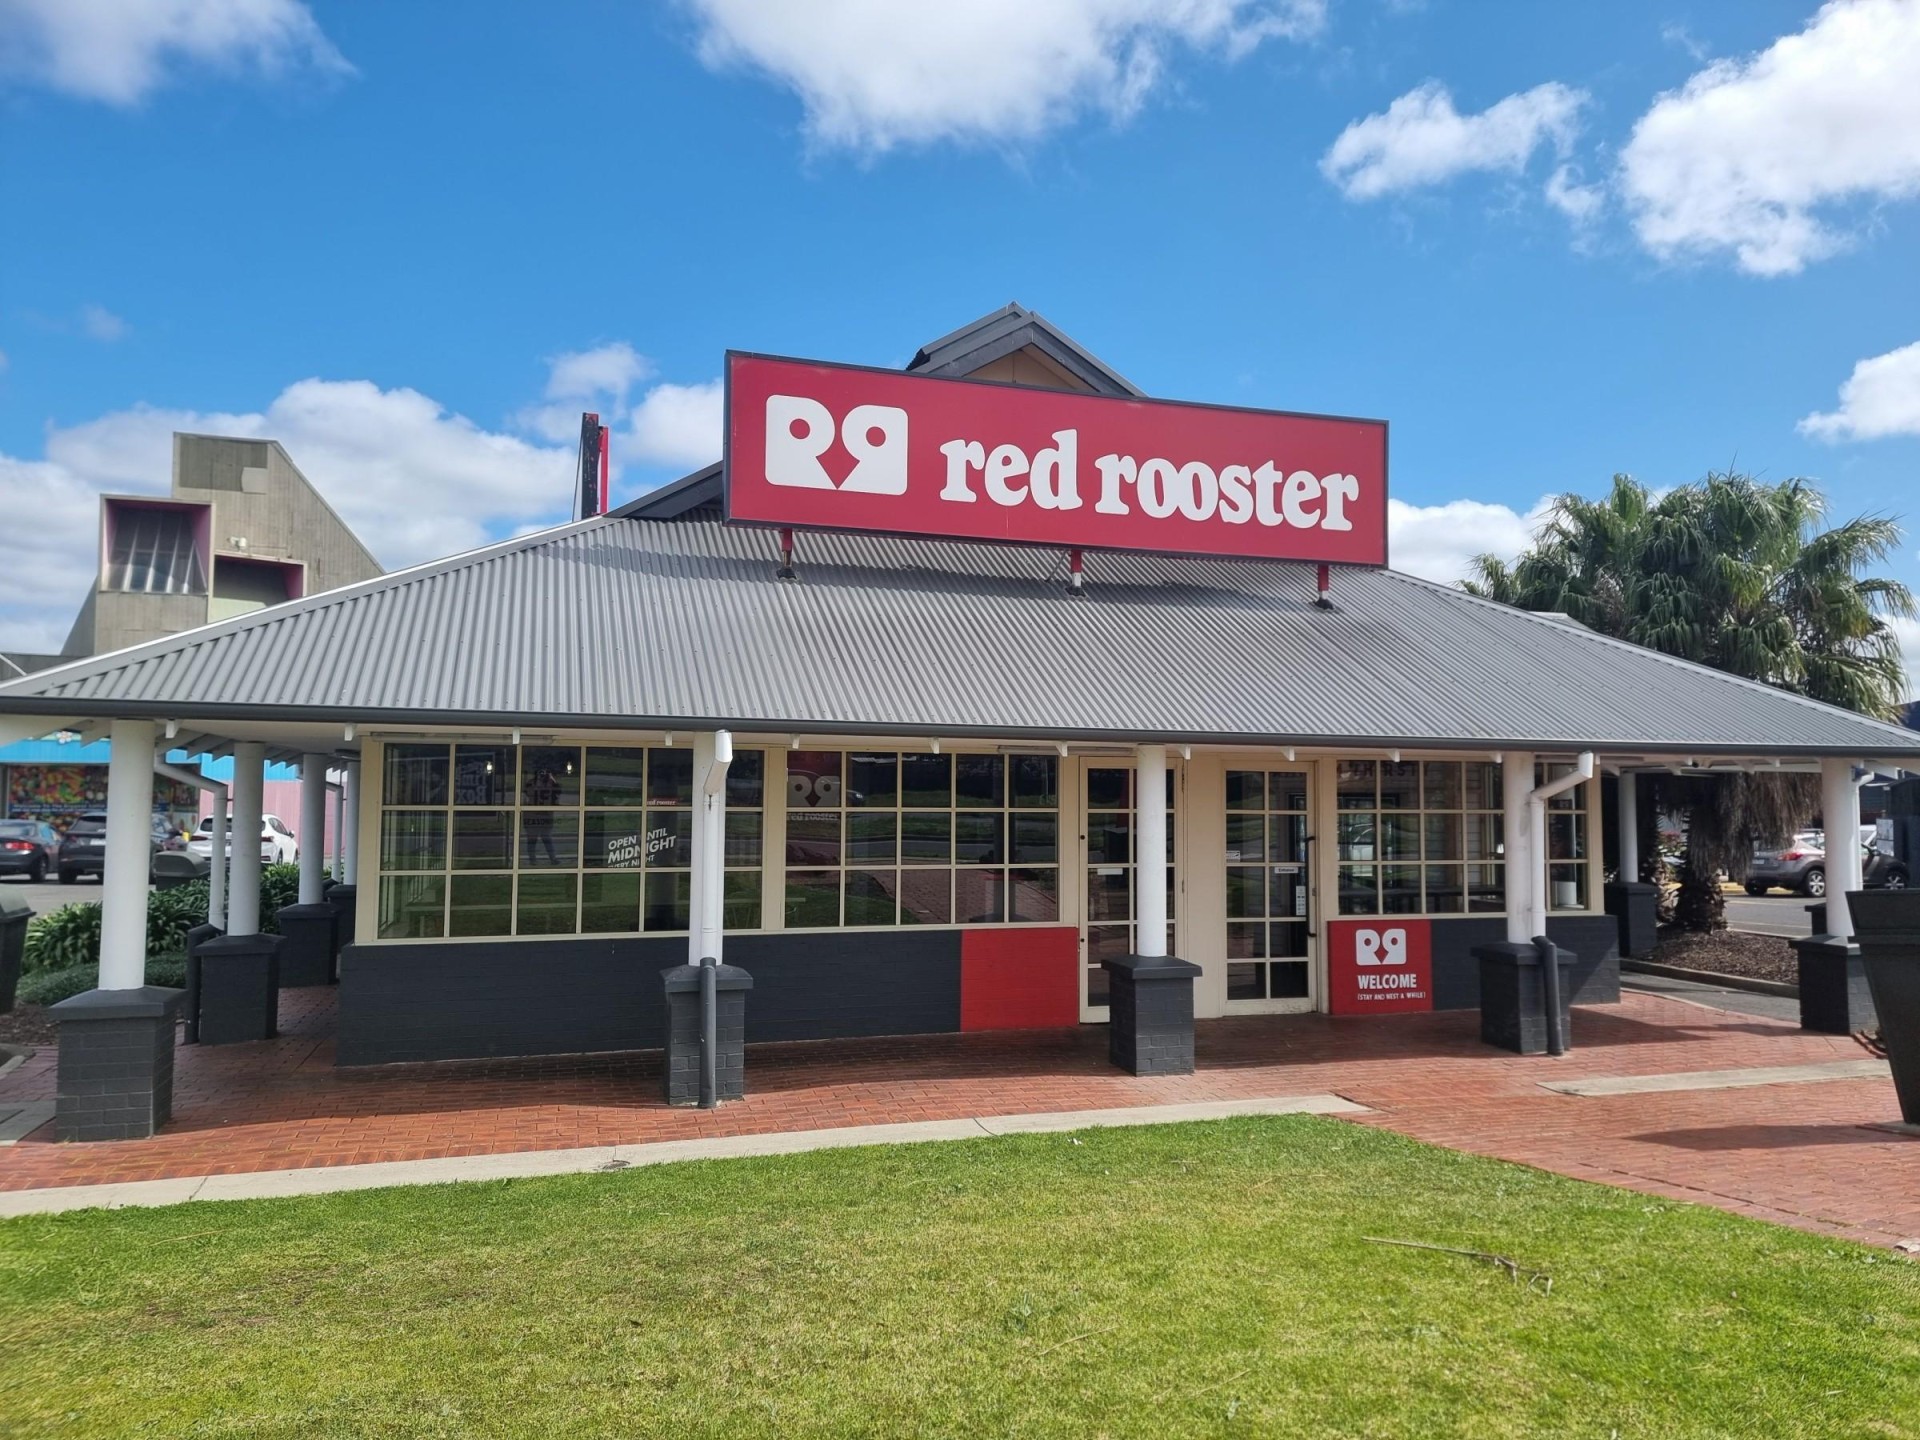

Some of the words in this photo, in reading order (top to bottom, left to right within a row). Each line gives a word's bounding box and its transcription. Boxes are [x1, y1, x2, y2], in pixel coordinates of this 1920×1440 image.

[940, 428, 1082, 510] red
[1095, 452, 1359, 532] rooster
[608, 835, 637, 850] OPEN
[645, 827, 668, 840] NTIL
[1357, 973, 1417, 989] WELCOME
